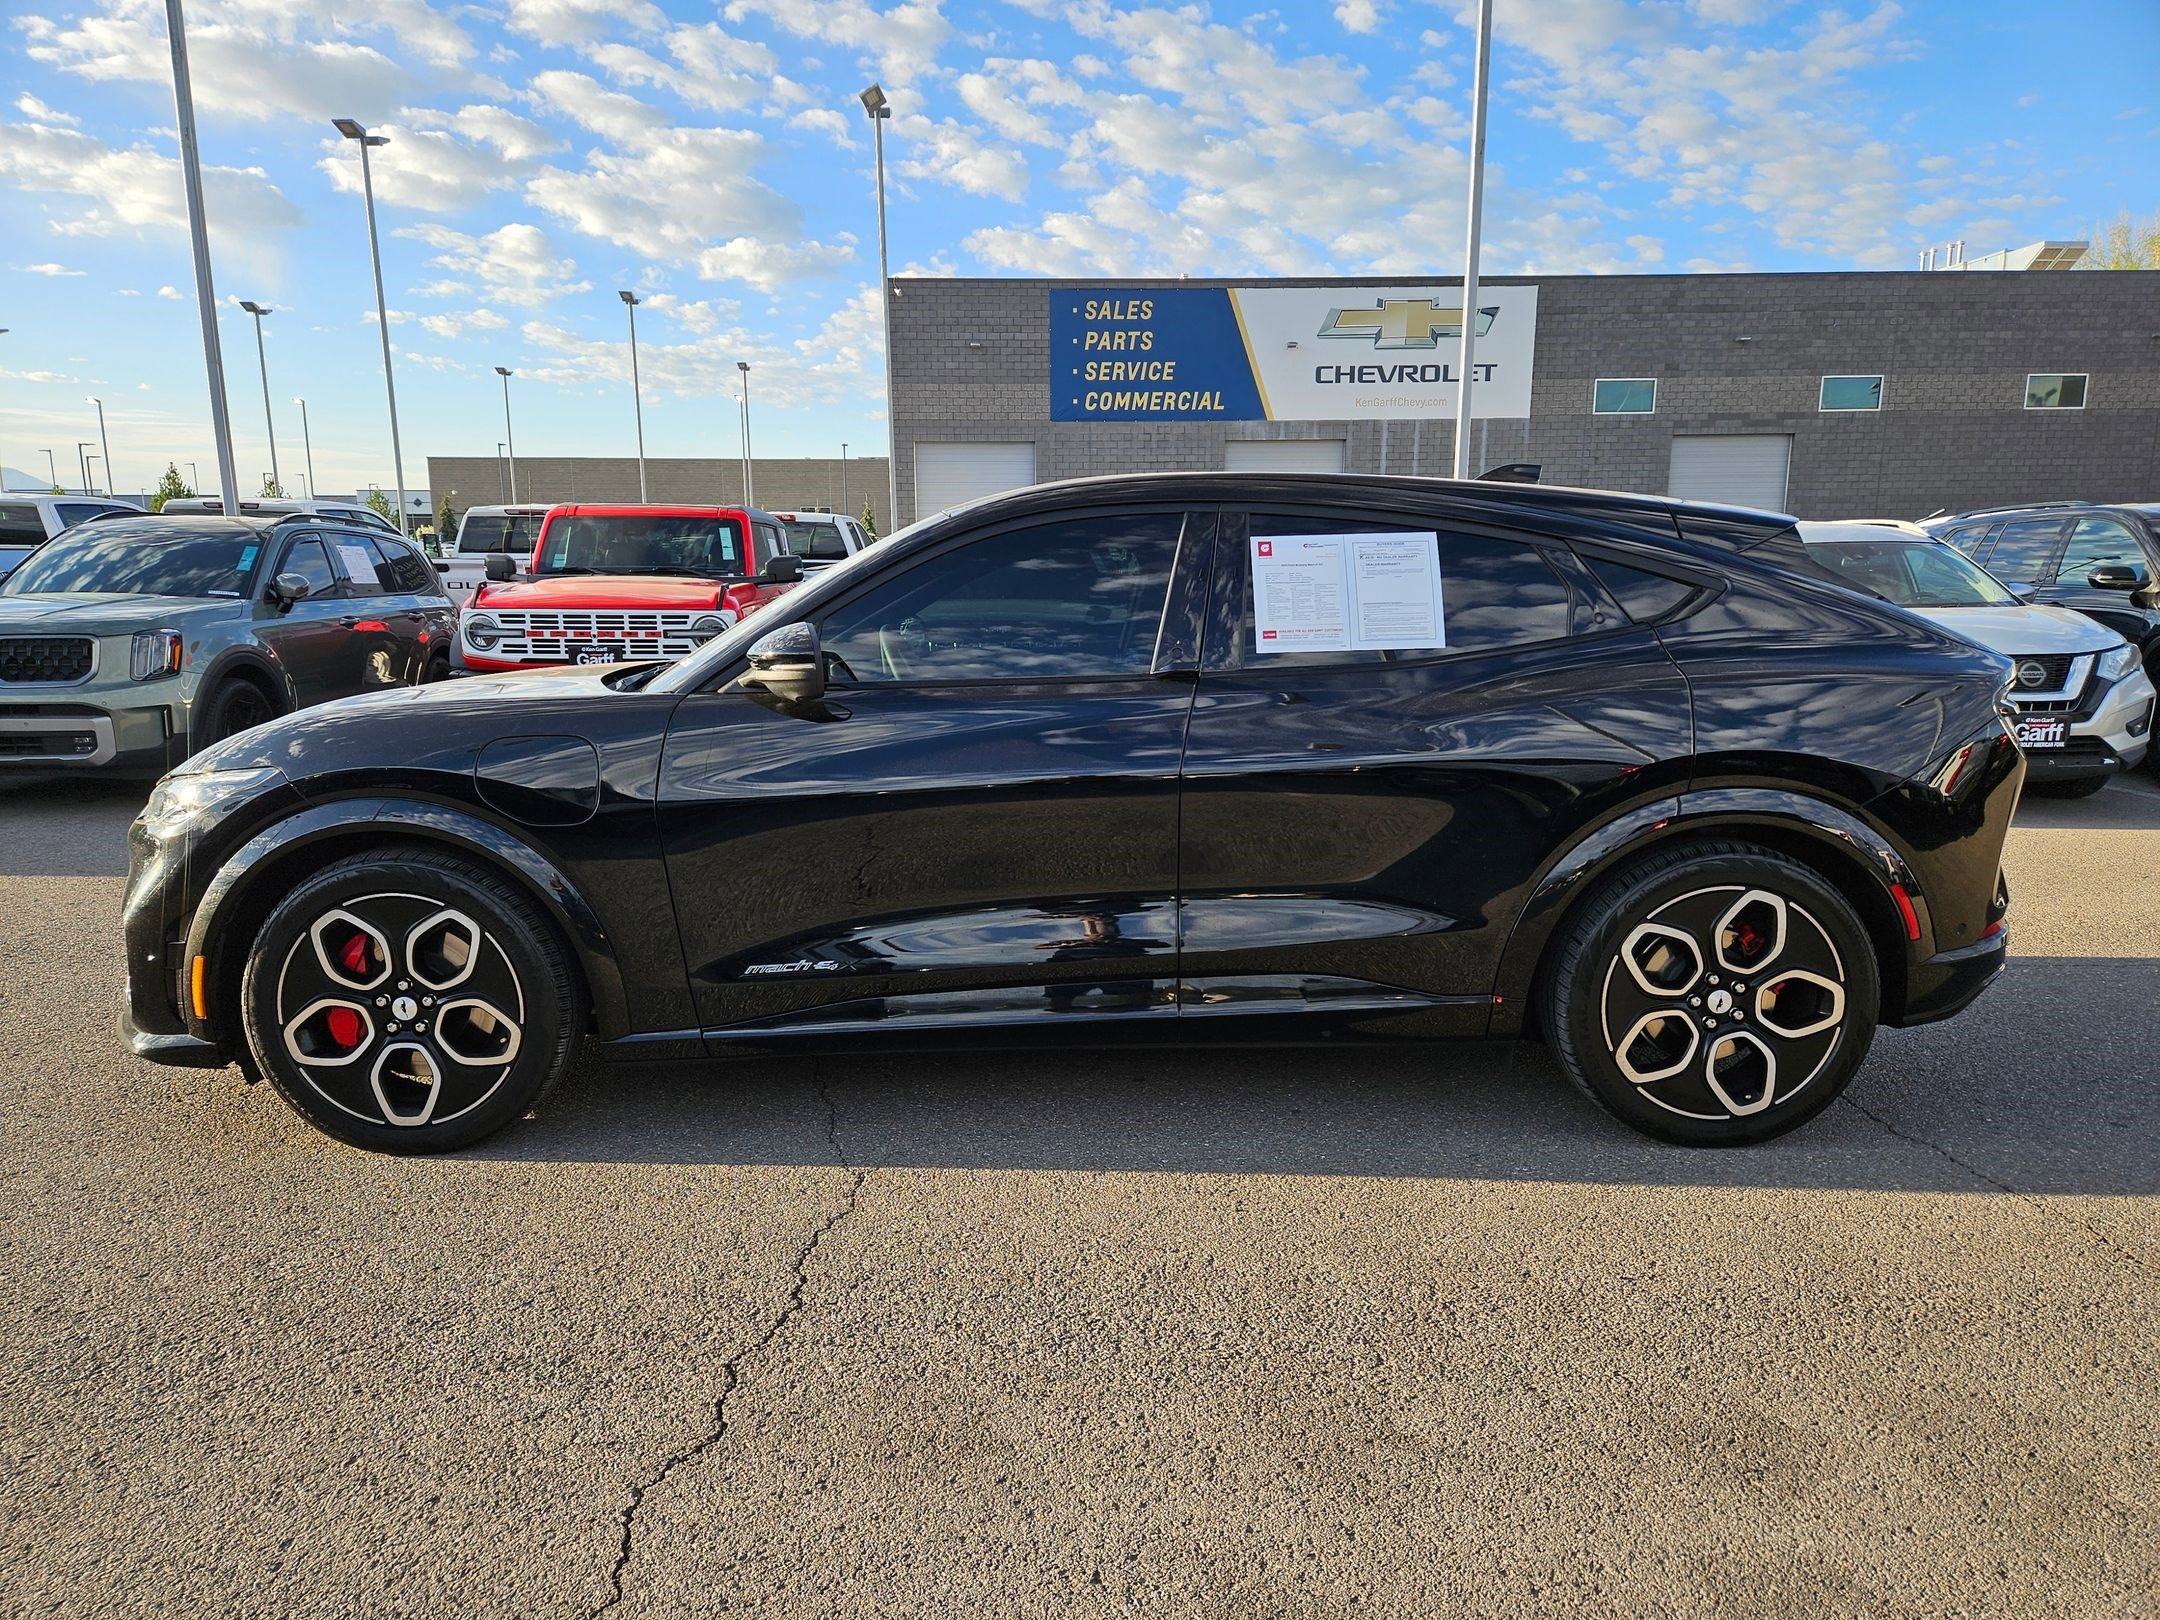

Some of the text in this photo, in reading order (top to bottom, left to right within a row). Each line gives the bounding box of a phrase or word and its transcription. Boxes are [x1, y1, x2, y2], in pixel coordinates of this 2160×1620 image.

[1084, 300, 1154, 320] SALES
[1084, 331, 1154, 351] PARTS
[1084, 361, 1176, 381] SERVICE
[1084, 391, 1225, 411] COMMERCIAL
[1355, 396, 1448, 409] KenGarffChevy.com
[576, 653, 615, 665] Garff
[2014, 723, 2065, 741] Garff
